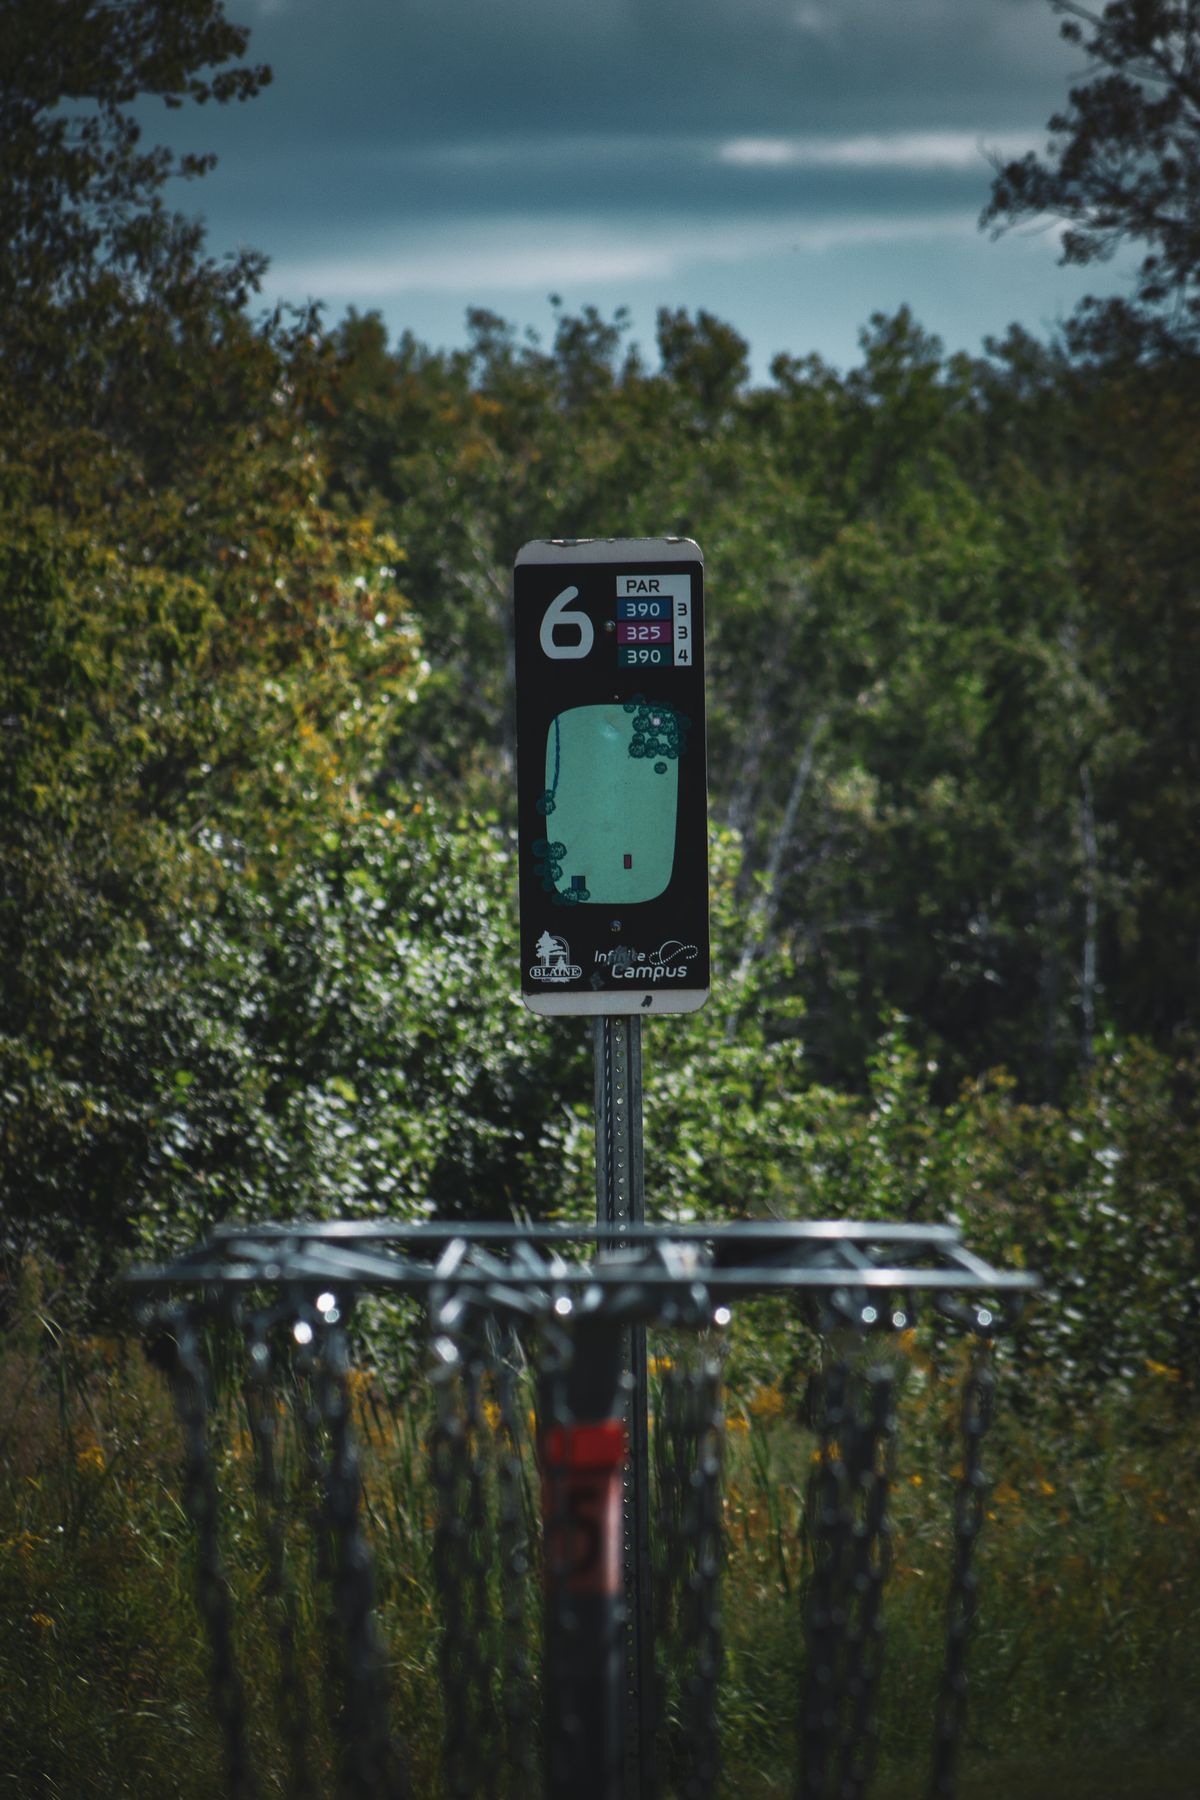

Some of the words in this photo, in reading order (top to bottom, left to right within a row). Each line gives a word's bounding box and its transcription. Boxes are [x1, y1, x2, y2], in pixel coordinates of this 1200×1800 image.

[626, 579, 660, 593] PAR
[626, 602, 660, 617] 390
[677, 602, 688, 617] 3
[539, 585, 595, 660] 6
[627, 626, 661, 640] 325
[677, 625, 688, 640] 3
[627, 649, 661, 664] 390
[677, 649, 689, 663] 4
[533, 967, 580, 977] BLAINE
[611, 963, 688, 982] Campus
